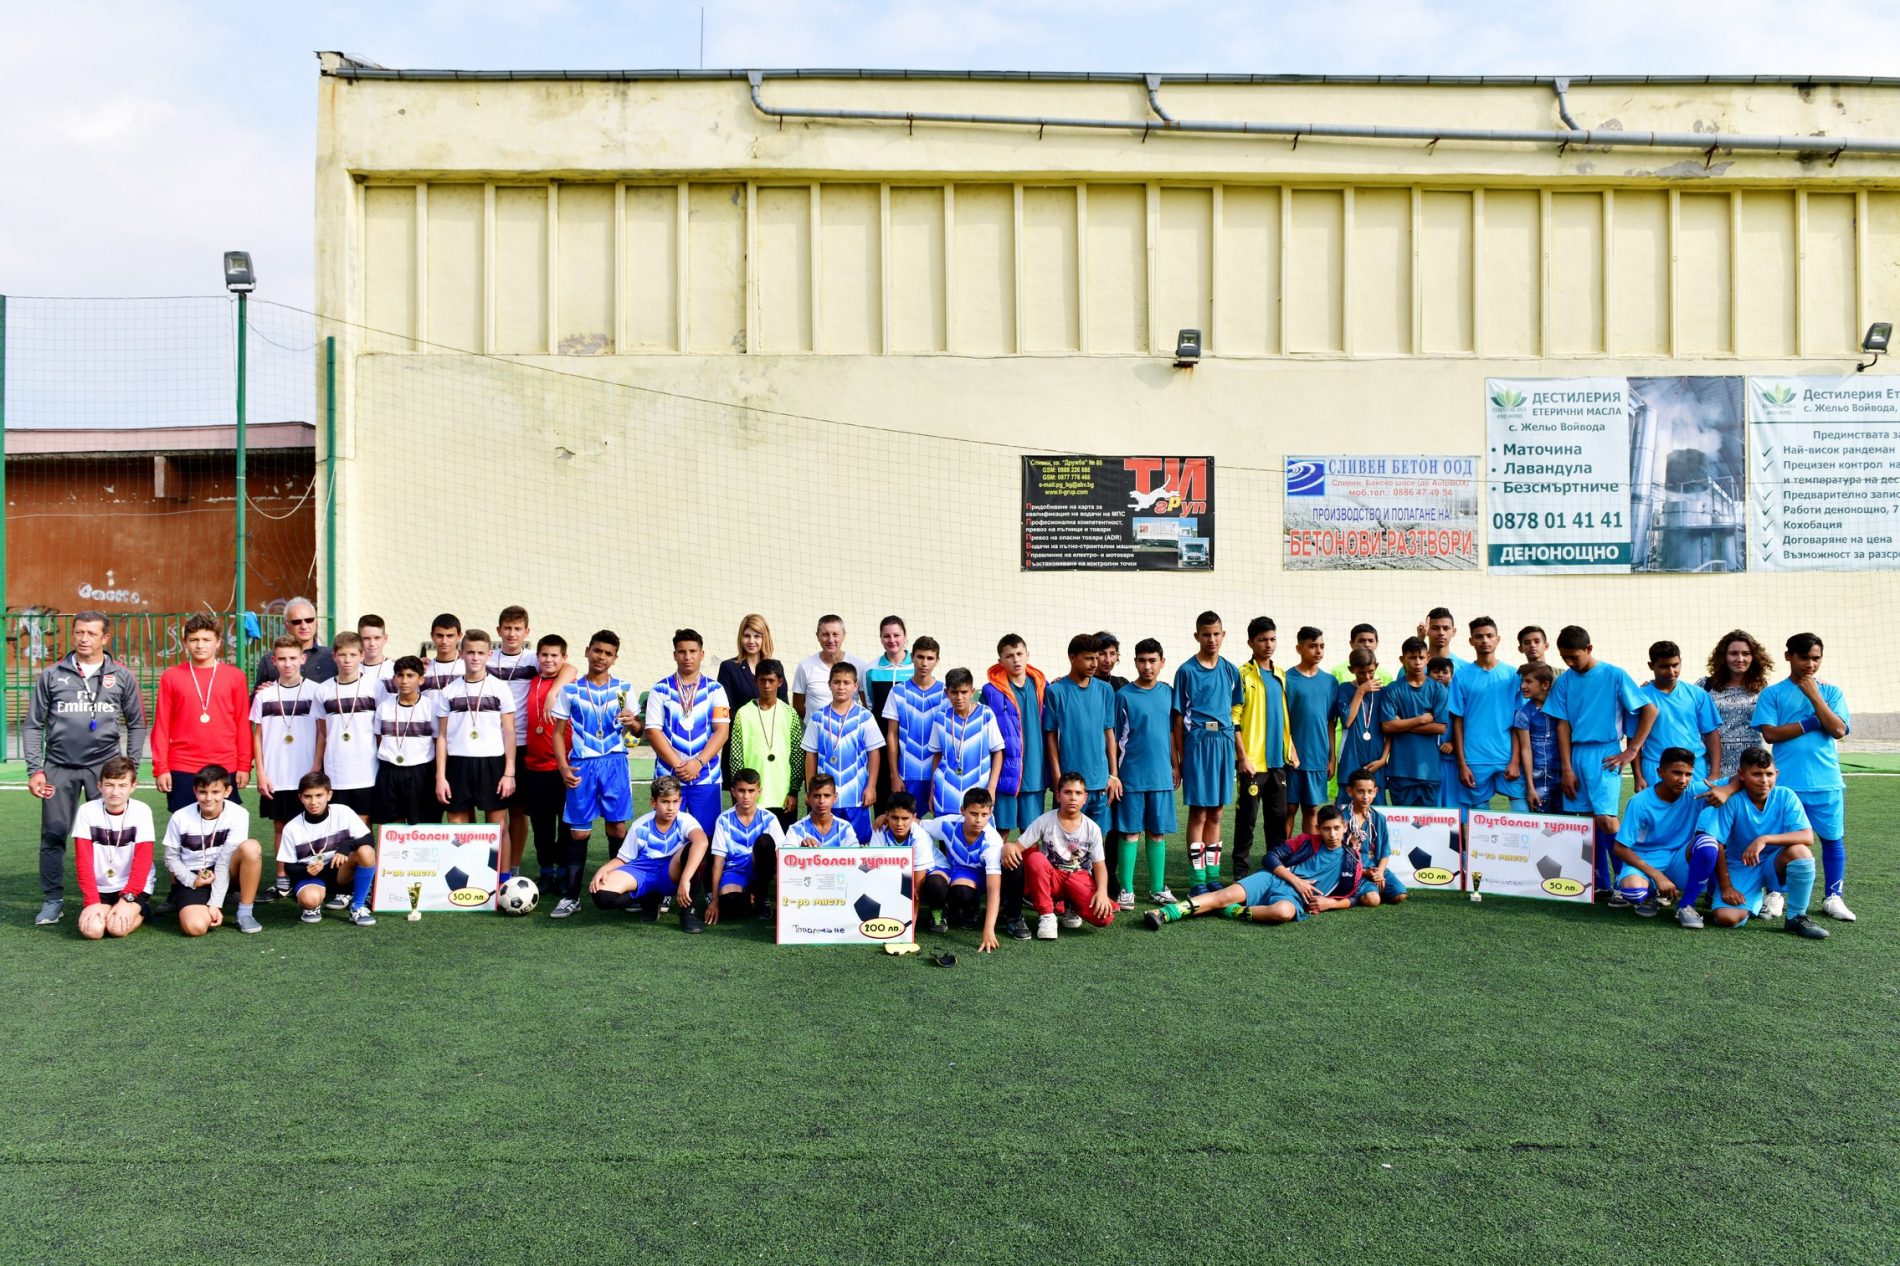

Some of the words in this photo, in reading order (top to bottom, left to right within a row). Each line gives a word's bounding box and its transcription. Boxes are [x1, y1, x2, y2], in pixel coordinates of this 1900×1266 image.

[1533, 392, 1621, 404] ДЕСТИЛЕРИЯ
[1803, 389, 1881, 402] Дестилерия
[1532, 408, 1583, 416] ЕТЕРИЧНИ
[1586, 407, 1621, 415] МАСЛА
[1815, 404, 1850, 412] Жельо
[1852, 403, 1898, 414] Войвода,
[1509, 424, 1517, 432] с.
[1521, 423, 1557, 432] Жельо
[1561, 422, 1605, 433] Войвода
[1813, 431, 1890, 440] Предимствата
[1503, 444, 1582, 456] Маточина
[1784, 446, 1839, 454] Най-висок
[1842, 447, 1895, 458] рандеман
[1328, 459, 1386, 474] СЛИВЕН
[1392, 459, 1438, 474] БЕТОН
[1444, 459, 1472, 477] ООД
[1504, 463, 1592, 475] Лавандула
[1784, 461, 1836, 471] Прецизен
[1839, 462, 1882, 471] контрол
[1124, 458, 1206, 500] ТИ
[1794, 476, 1861, 487] температура
[1865, 476, 1878, 484] на
[1503, 482, 1619, 495] Безсмъртниче
[1784, 491, 1868, 501] Предварително
[1313, 508, 1381, 522] ПРОИЗВОДСТВО
[1384, 508, 1389, 520] И
[1392, 508, 1436, 520] ПОЛАГАНЕ
[1439, 508, 1450, 519] НА
[1784, 506, 1821, 515] Работи
[1824, 506, 1889, 516] денонощно,
[1893, 505, 1898, 513] 7
[1026, 518, 1076, 526] Професионална
[1493, 512, 1538, 529] 0878
[1544, 512, 1566, 529] 01
[1573, 512, 1594, 529] 41
[1601, 511, 1622, 528] 41
[1784, 521, 1842, 530] Кохобация
[1290, 529, 1381, 556] БЕТОНОВИ
[1387, 530, 1473, 556] РАЗТВОРИ
[1783, 536, 1848, 546] Договаряне
[1867, 535, 1892, 545] цена
[1026, 551, 1063, 559] Управление
[1501, 546, 1619, 563] ДЕНОНОЩНО
[1784, 550, 1850, 559] Възможност
[1854, 551, 1865, 559] за
[1413, 815, 1457, 827] турнир
[1474, 814, 1539, 829] Футболен
[1543, 821, 1590, 834] турнир
[385, 830, 450, 843] Футболен
[453, 831, 498, 844] турнир
[784, 854, 855, 870] Футболен
[860, 856, 909, 870] турнир
[1418, 871, 1435, 880] 100
[1549, 882, 1563, 891] 50
[1565, 884, 1578, 892] лв.
[452, 892, 471, 901] 300
[864, 924, 885, 932] 200
